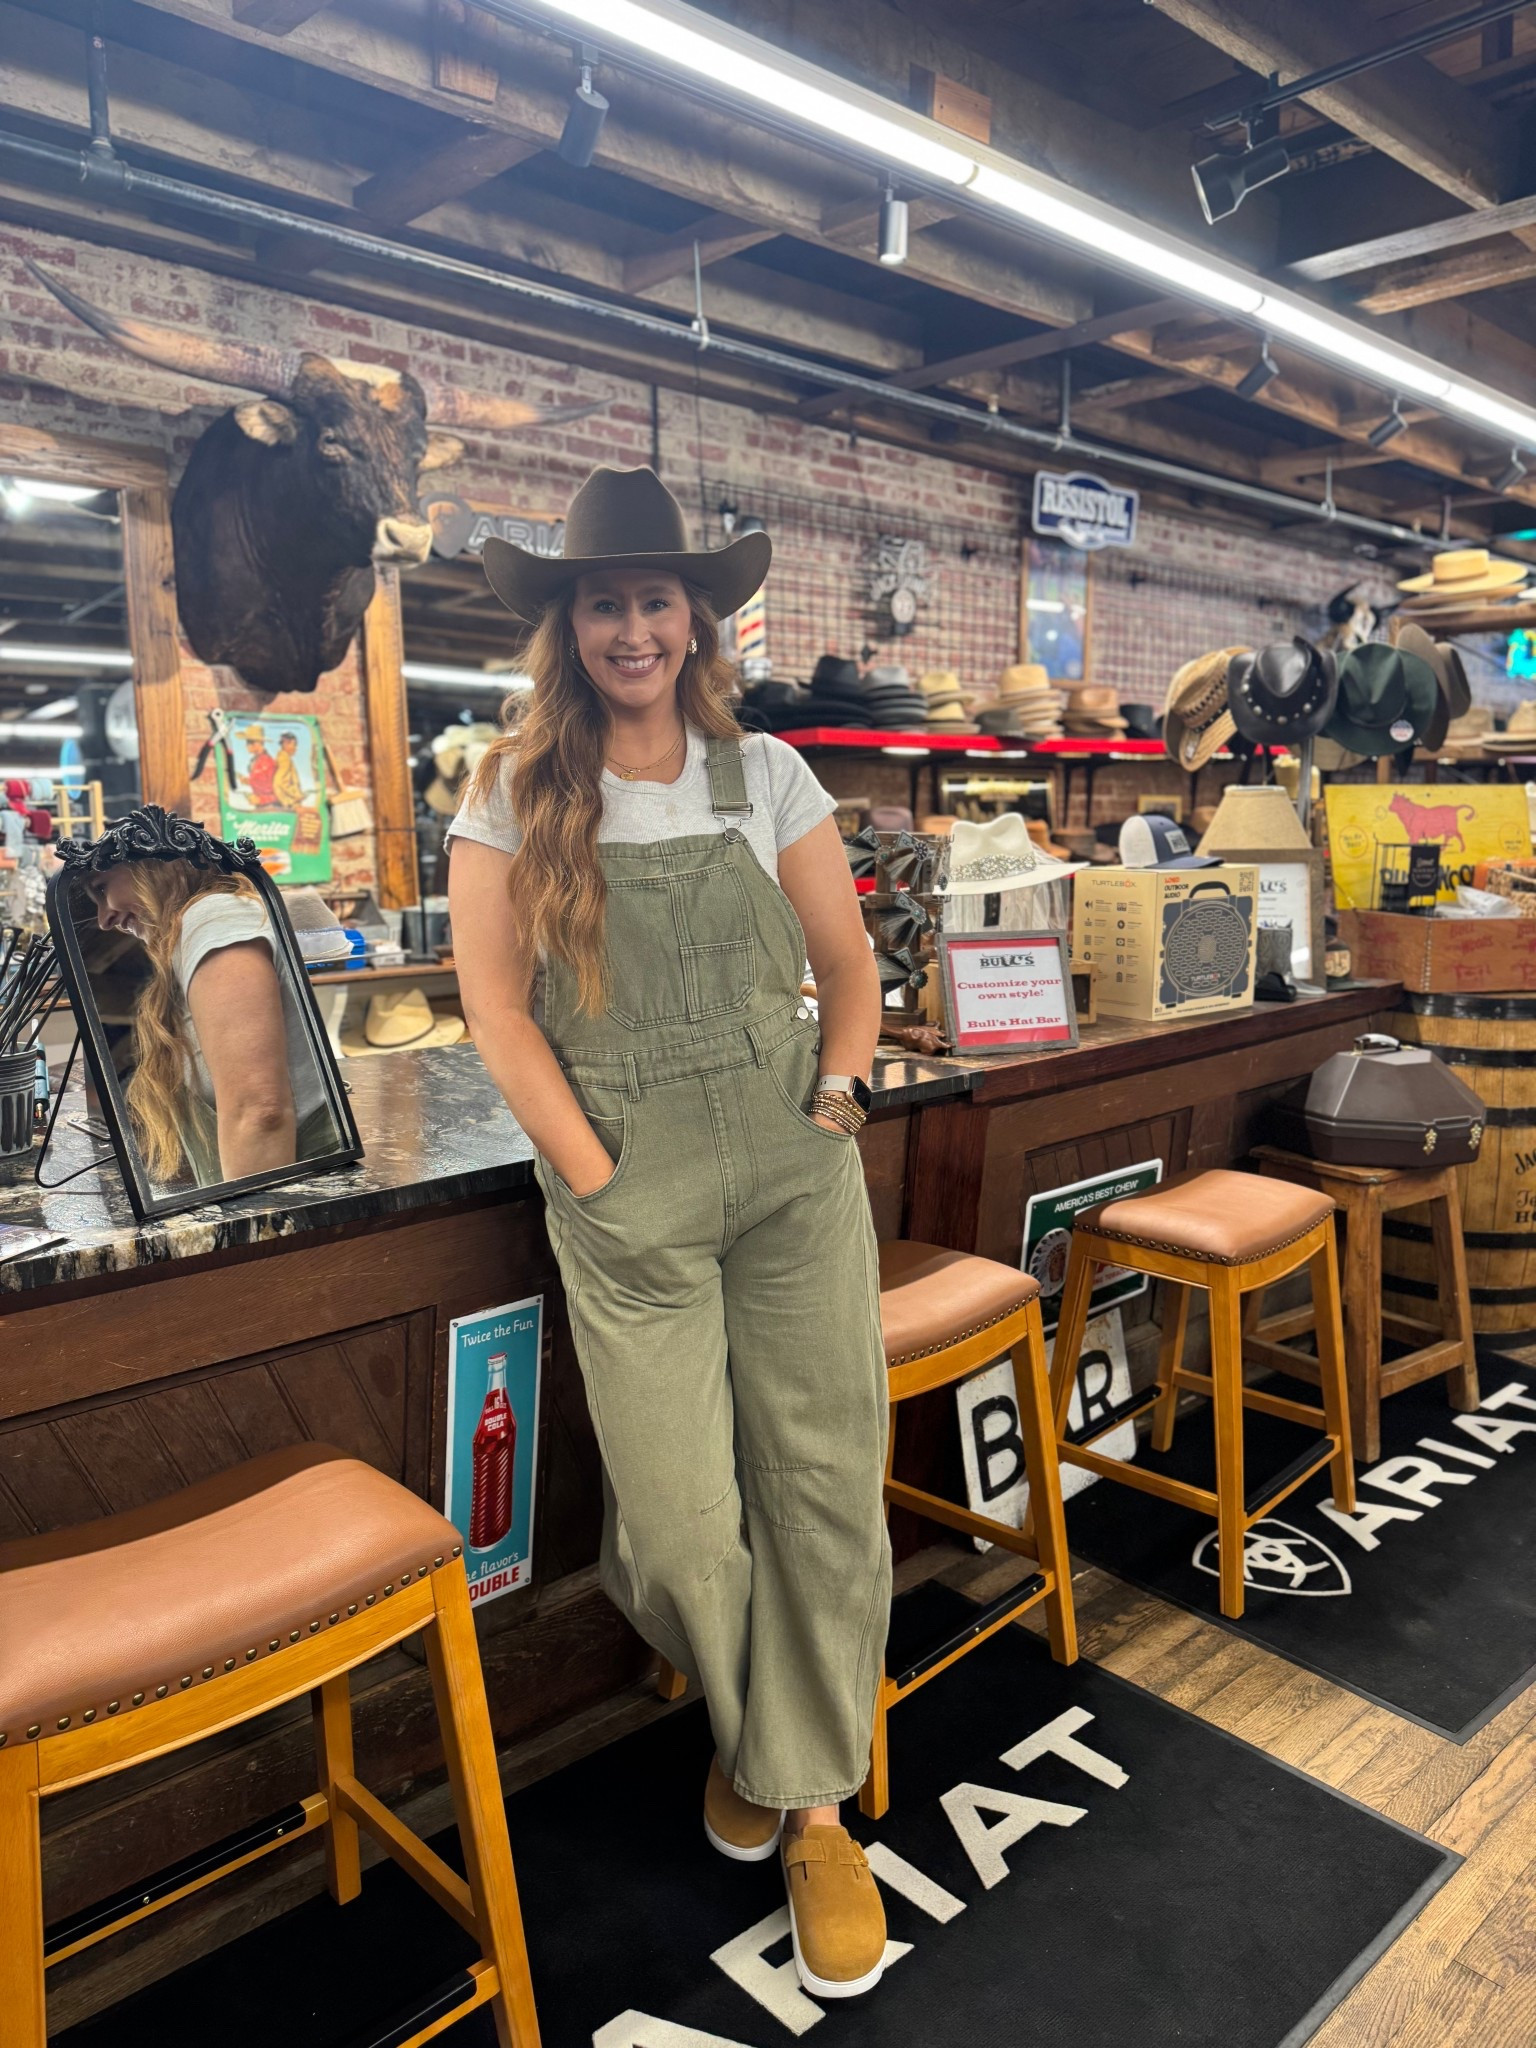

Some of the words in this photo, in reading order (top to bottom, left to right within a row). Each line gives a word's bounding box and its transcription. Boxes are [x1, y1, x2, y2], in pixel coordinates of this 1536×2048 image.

[1041, 480, 1130, 528] RESISTOL
[1092, 879, 1137, 888] TURTLEBOX
[1164, 884, 1189, 892] OUTDOOR
[979, 955, 1035, 968] BULL'S
[957, 979, 1028, 990] Customize
[1030, 977, 1062, 988] your
[978, 991, 1007, 1000] own
[1009, 988, 1045, 999] style!
[967, 1019, 1007, 1029] Bull's
[1008, 1017, 1034, 1026] Hat
[1035, 1015, 1062, 1024] Bar
[1054, 1192, 1095, 1213] AMERICA'S
[1094, 1186, 1114, 1200] BEST
[461, 1331, 492, 1348] Twice
[494, 1323, 511, 1339] the
[513, 1319, 534, 1334] Fun
[484, 1412, 508, 1427] DOUBLE
[487, 1420, 505, 1432] COLA
[972, 1350, 1114, 1502] BR
[1316, 1382, 1536, 1552] ARIAT
[480, 1551, 519, 1576] flavor's
[468, 1565, 520, 1602] OUBLE
